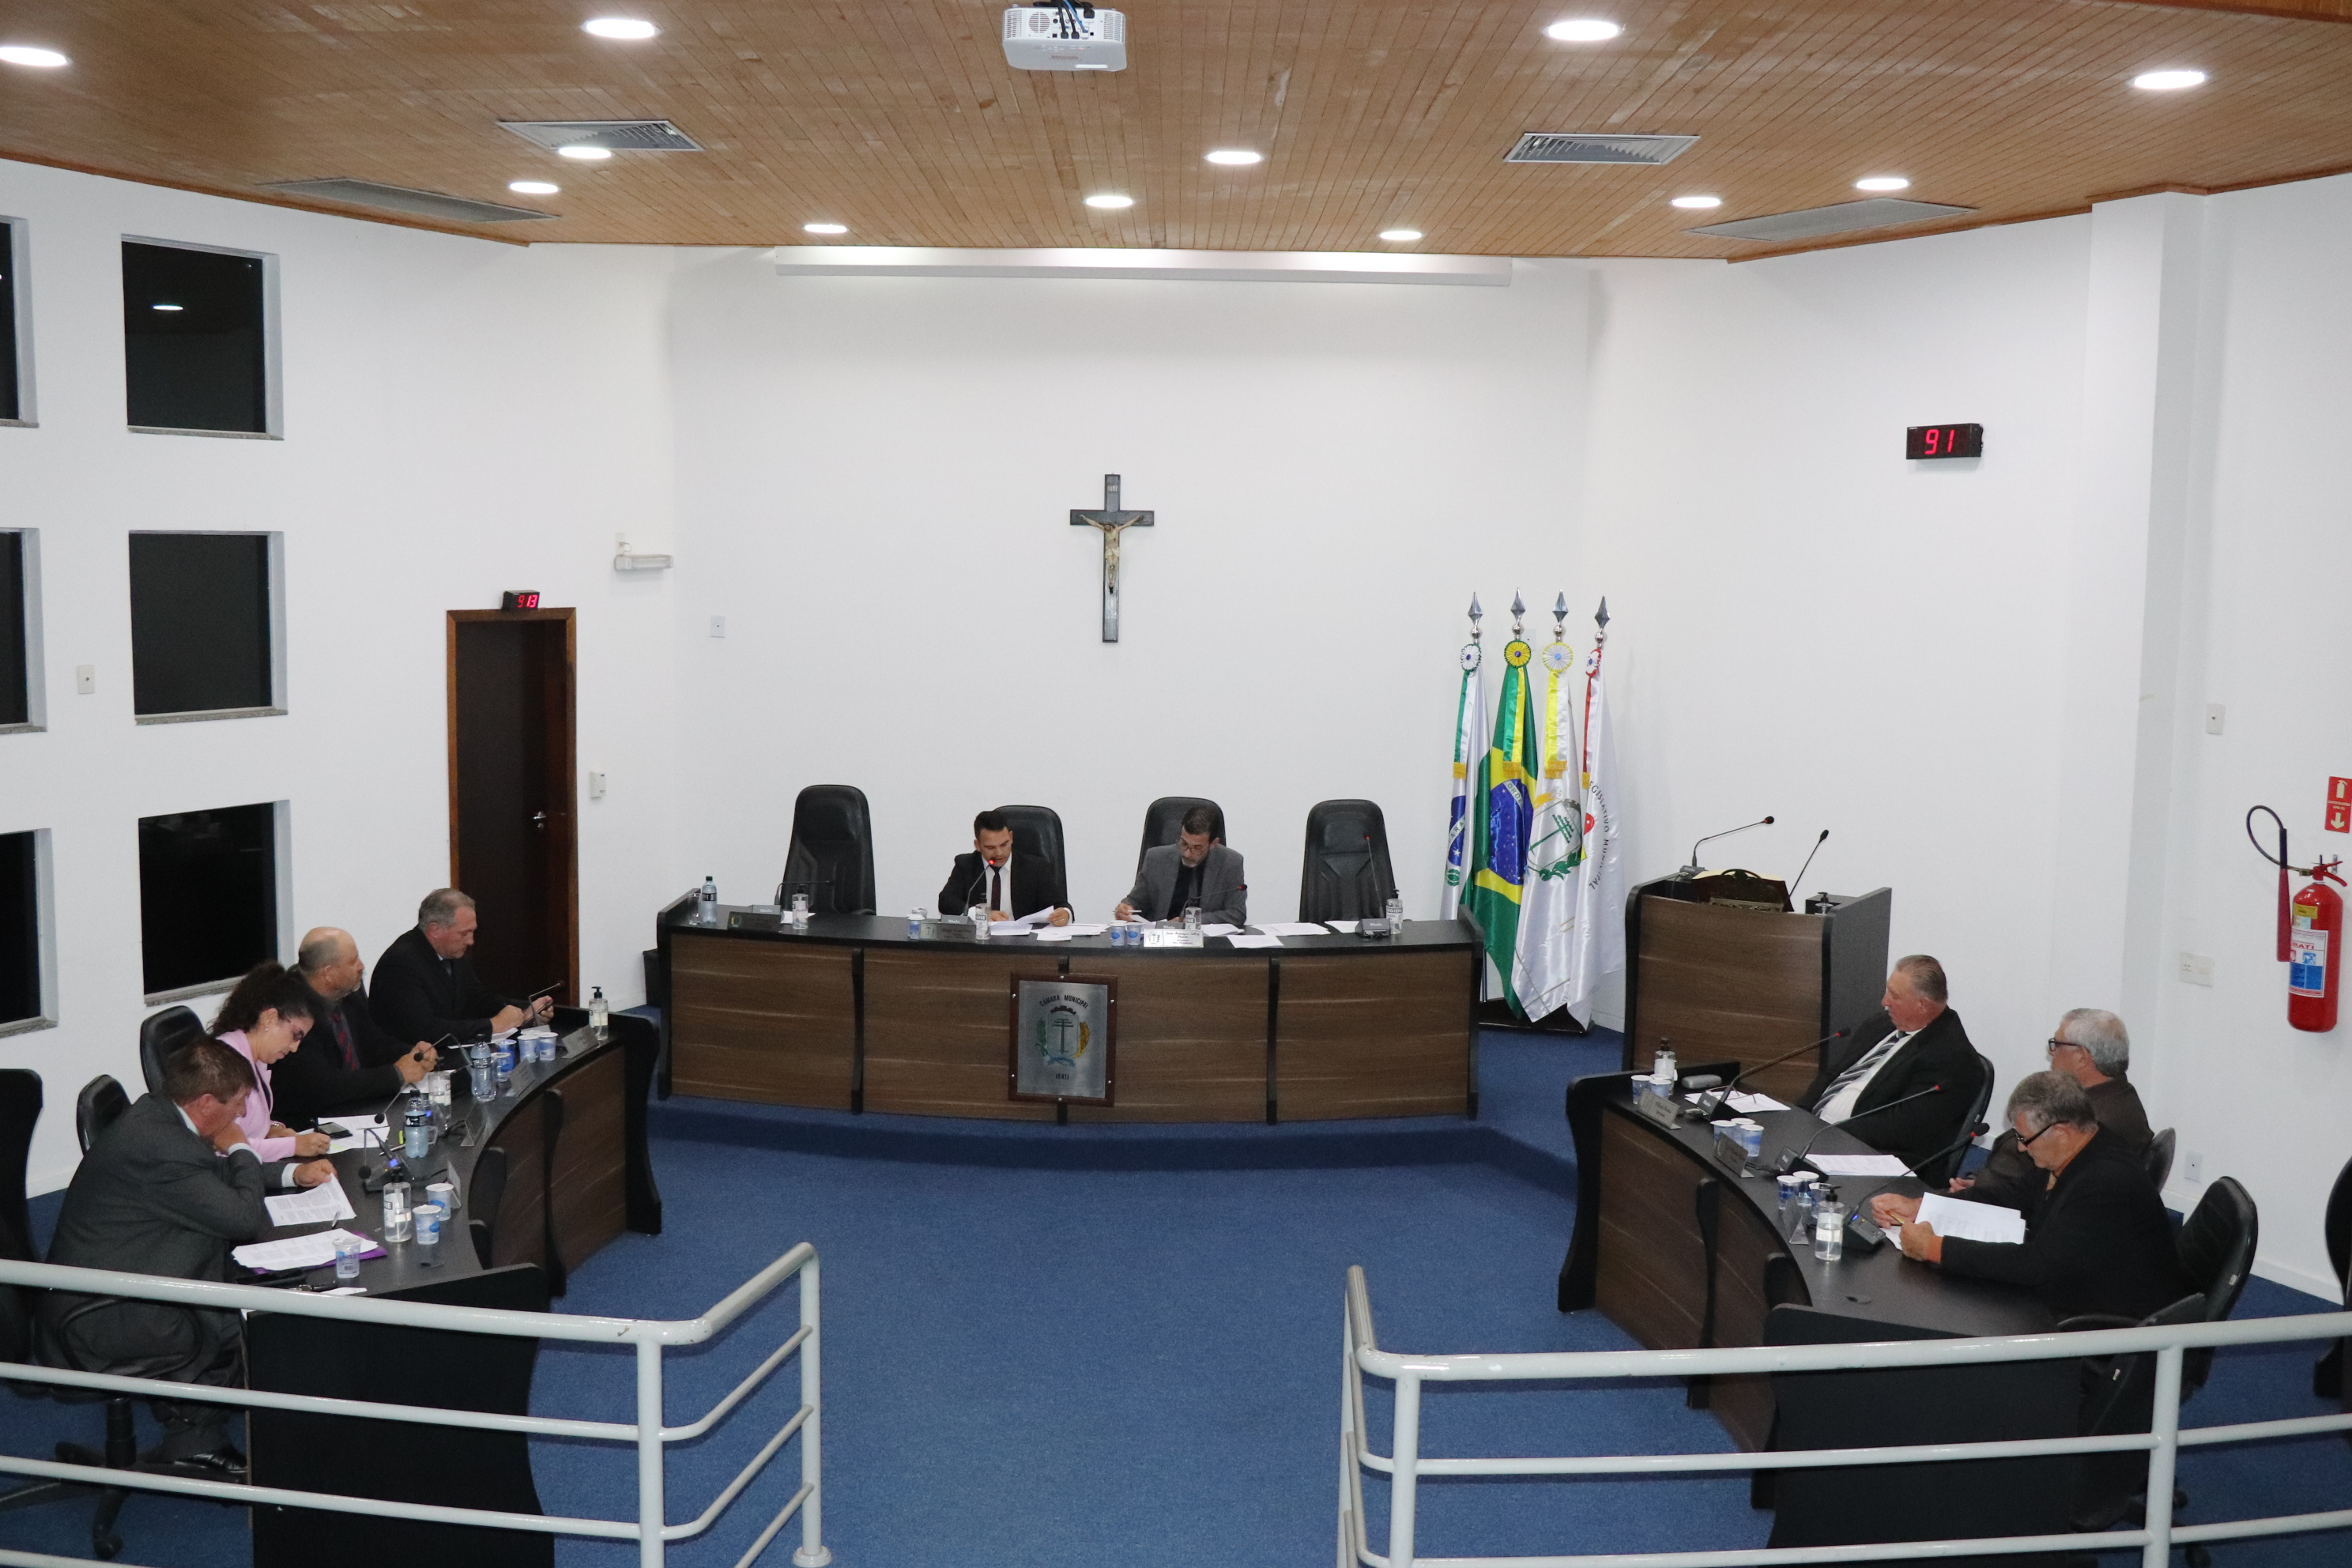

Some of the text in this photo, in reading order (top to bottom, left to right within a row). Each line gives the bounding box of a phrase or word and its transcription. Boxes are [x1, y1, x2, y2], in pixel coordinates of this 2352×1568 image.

[1924, 428, 1954, 455] 91
[1589, 781, 1610, 890] EGISLATIVO MUNICIPAL
[1064, 994, 1089, 1009] MUNICIPAL
